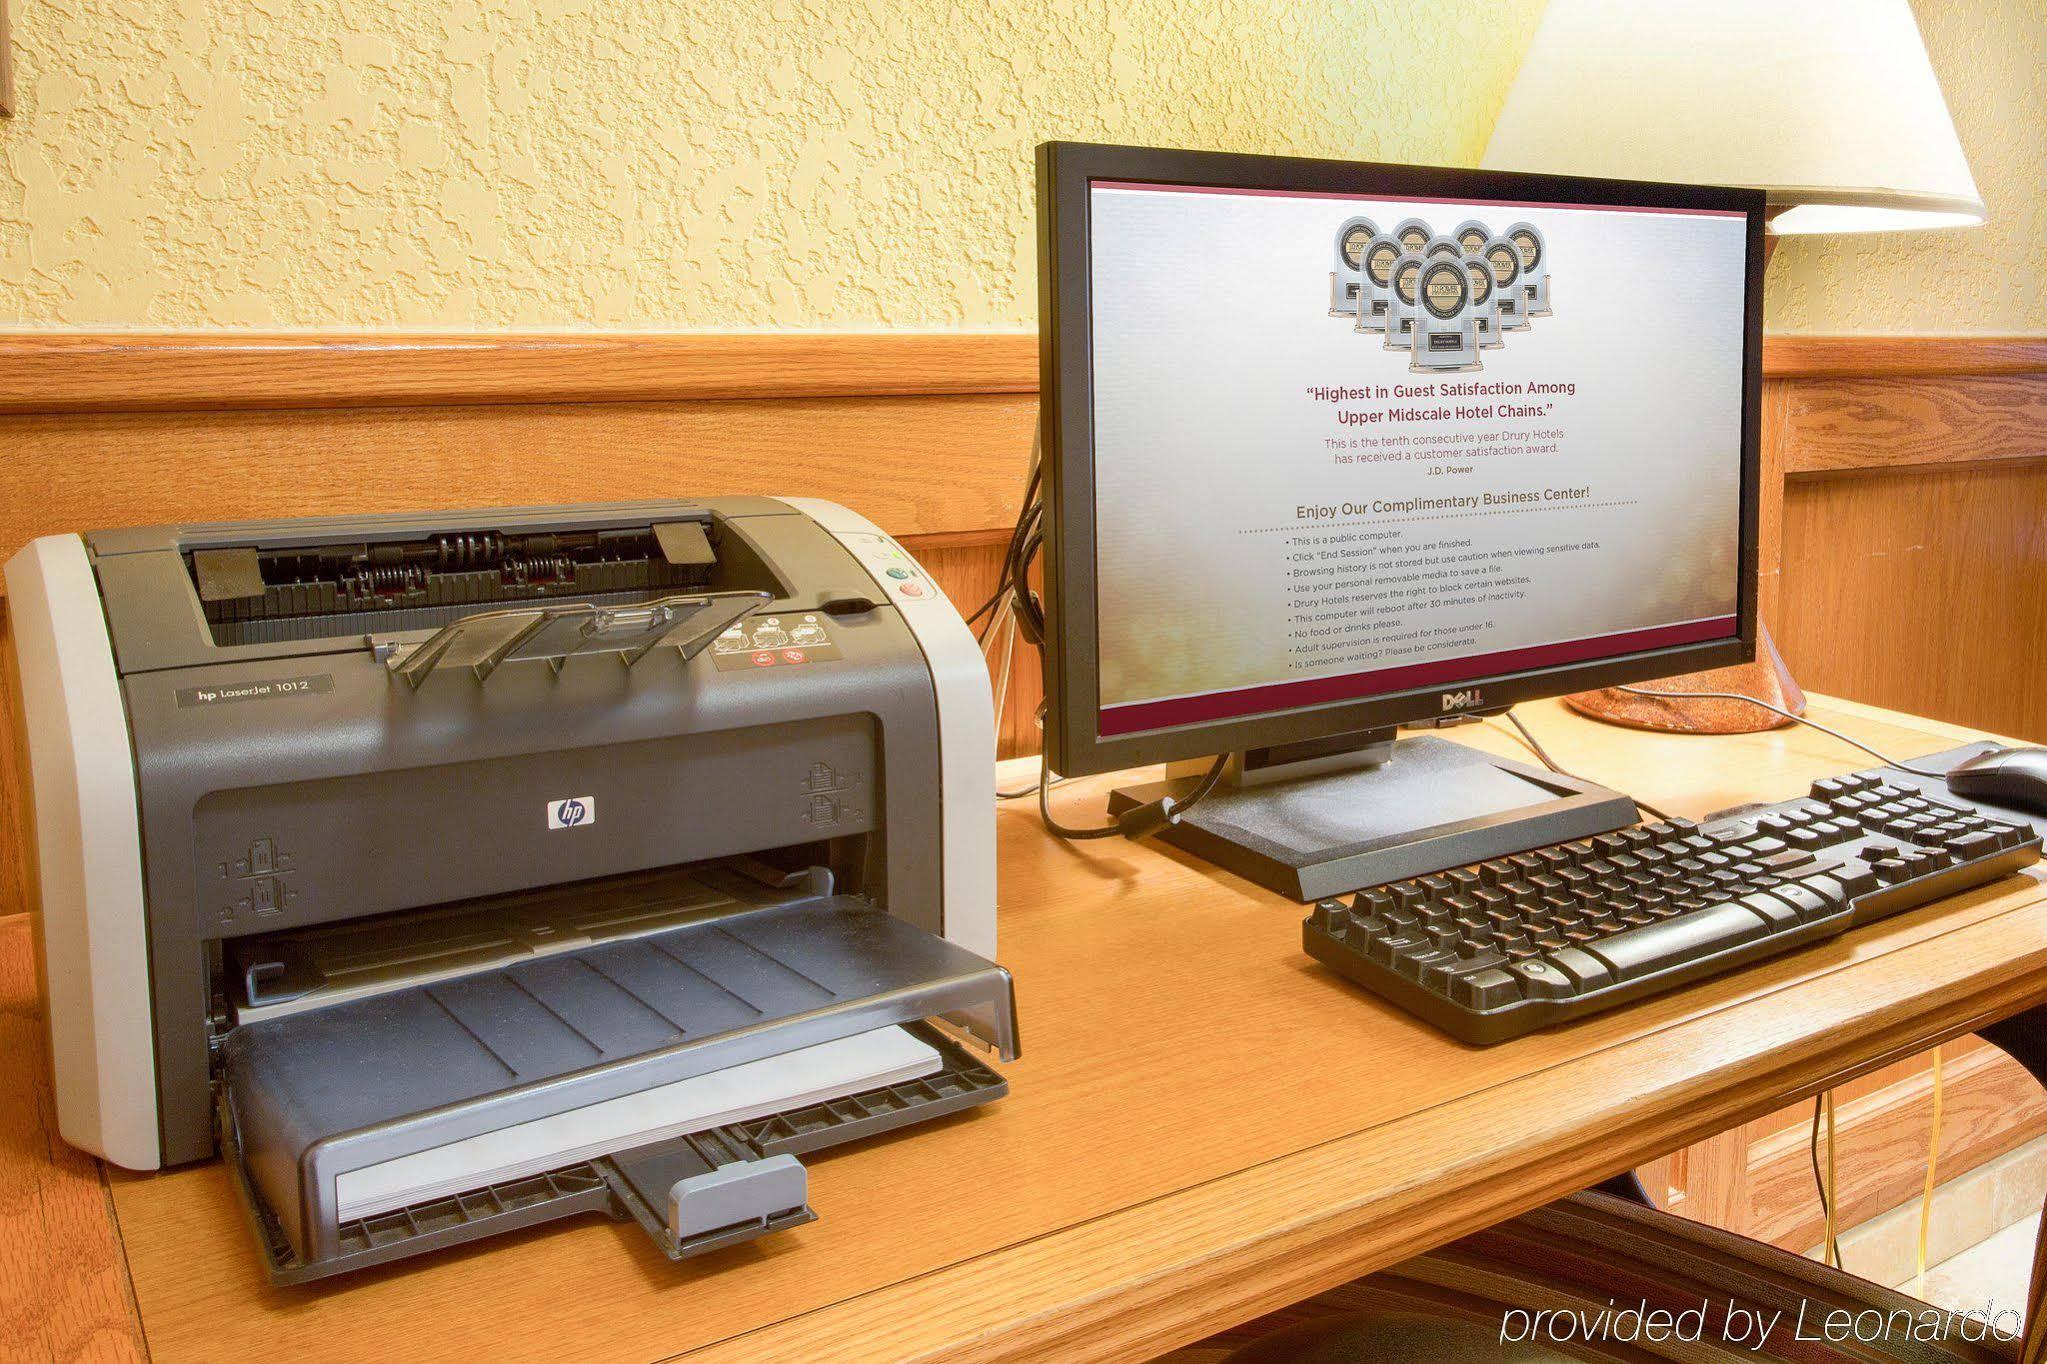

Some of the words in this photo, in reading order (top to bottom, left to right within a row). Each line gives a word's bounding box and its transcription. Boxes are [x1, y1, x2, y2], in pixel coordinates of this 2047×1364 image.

[1375, 386, 1388, 398] in
[1393, 384, 1435, 397] Guest
[1440, 382, 1522, 396] Satisfaction
[1527, 381, 1575, 395] Among
[1338, 410, 1383, 426] Upper
[1388, 406, 1451, 421] Midscale
[1455, 405, 1492, 419] Hotel
[1324, 438, 1346, 448] This
[1349, 438, 1357, 448] is
[1360, 437, 1378, 447] the
[1381, 435, 1409, 446] tenth
[1412, 433, 1474, 445] consecutive
[1477, 433, 1499, 444] year
[1502, 430, 1530, 442] Drury
[1532, 428, 1564, 439] Hotels
[1334, 453, 1353, 464] has
[1356, 450, 1401, 462] received
[1404, 452, 1411, 460] a
[1414, 449, 1463, 460] customer
[1465, 445, 1523, 457] satisfaction
[1525, 443, 1558, 454] award.
[1427, 466, 1444, 475] J.D.
[1446, 465, 1473, 474] Power
[1296, 504, 1337, 520] Enjoy
[1341, 502, 1368, 515] Our
[1372, 495, 1479, 513] Complimentary
[1483, 491, 1539, 505] Business
[1543, 486, 1589, 500] Center!
[1292, 536, 1310, 546] This
[1312, 536, 1320, 544] is
[1329, 533, 1356, 544] public
[1292, 552, 1314, 562] Click
[1379, 545, 1402, 554] when
[1404, 544, 1420, 553] you
[1293, 566, 1334, 577] Browsing
[1337, 564, 1367, 573] history
[1369, 561, 1376, 570] is
[1378, 560, 1393, 569] not
[1395, 557, 1422, 568] stored
[1424, 556, 1439, 565] but
[1441, 555, 1455, 563] use
[1457, 551, 1488, 561] caution
[1490, 550, 1512, 558] when
[1514, 546, 1544, 558] viewing
[1546, 543, 1579, 553] sensitive
[1293, 584, 1310, 593] Use
[1312, 582, 1332, 592] your
[1335, 577, 1372, 590] personal
[1374, 573, 1420, 584] removable
[1421, 570, 1447, 579] media
[1460, 568, 1479, 576] save
[1294, 599, 1319, 608] Drury
[1321, 594, 1349, 605] Hotels
[1351, 591, 1388, 601] reserves
[1389, 589, 1404, 598] the
[1406, 586, 1426, 599] right
[1439, 582, 1462, 592] block
[1464, 579, 1493, 590] certain
[1295, 614, 1312, 623] This
[1314, 610, 1357, 621] computer
[1359, 606, 1374, 615] will
[1376, 603, 1405, 613] reboot
[1407, 601, 1427, 610] after
[1429, 599, 1441, 608] 30
[1443, 595, 1475, 606] minutes
[1477, 594, 1486, 602] of
[1294, 629, 1308, 638] No
[1310, 626, 1331, 636] food
[1332, 626, 1342, 634] or
[1344, 622, 1371, 632] drinks
[1294, 643, 1319, 654] Adult
[1321, 638, 1370, 653] supervision
[1372, 634, 1379, 643] is
[1381, 630, 1418, 642] required
[1419, 629, 1432, 638] for
[1434, 627, 1457, 635] those
[1458, 623, 1482, 633] under
[1295, 659, 1302, 668] Is
[1304, 655, 1344, 668] someone
[1346, 649, 1382, 664] waiting?
[1384, 647, 1412, 655] Please
[1414, 643, 1425, 652] be
[198, 691, 217, 701] hp
[220, 686, 271, 698] LaserJet
[276, 681, 309, 692] 1012
[1442, 689, 1483, 711] DELL
[561, 799, 583, 827] hp
